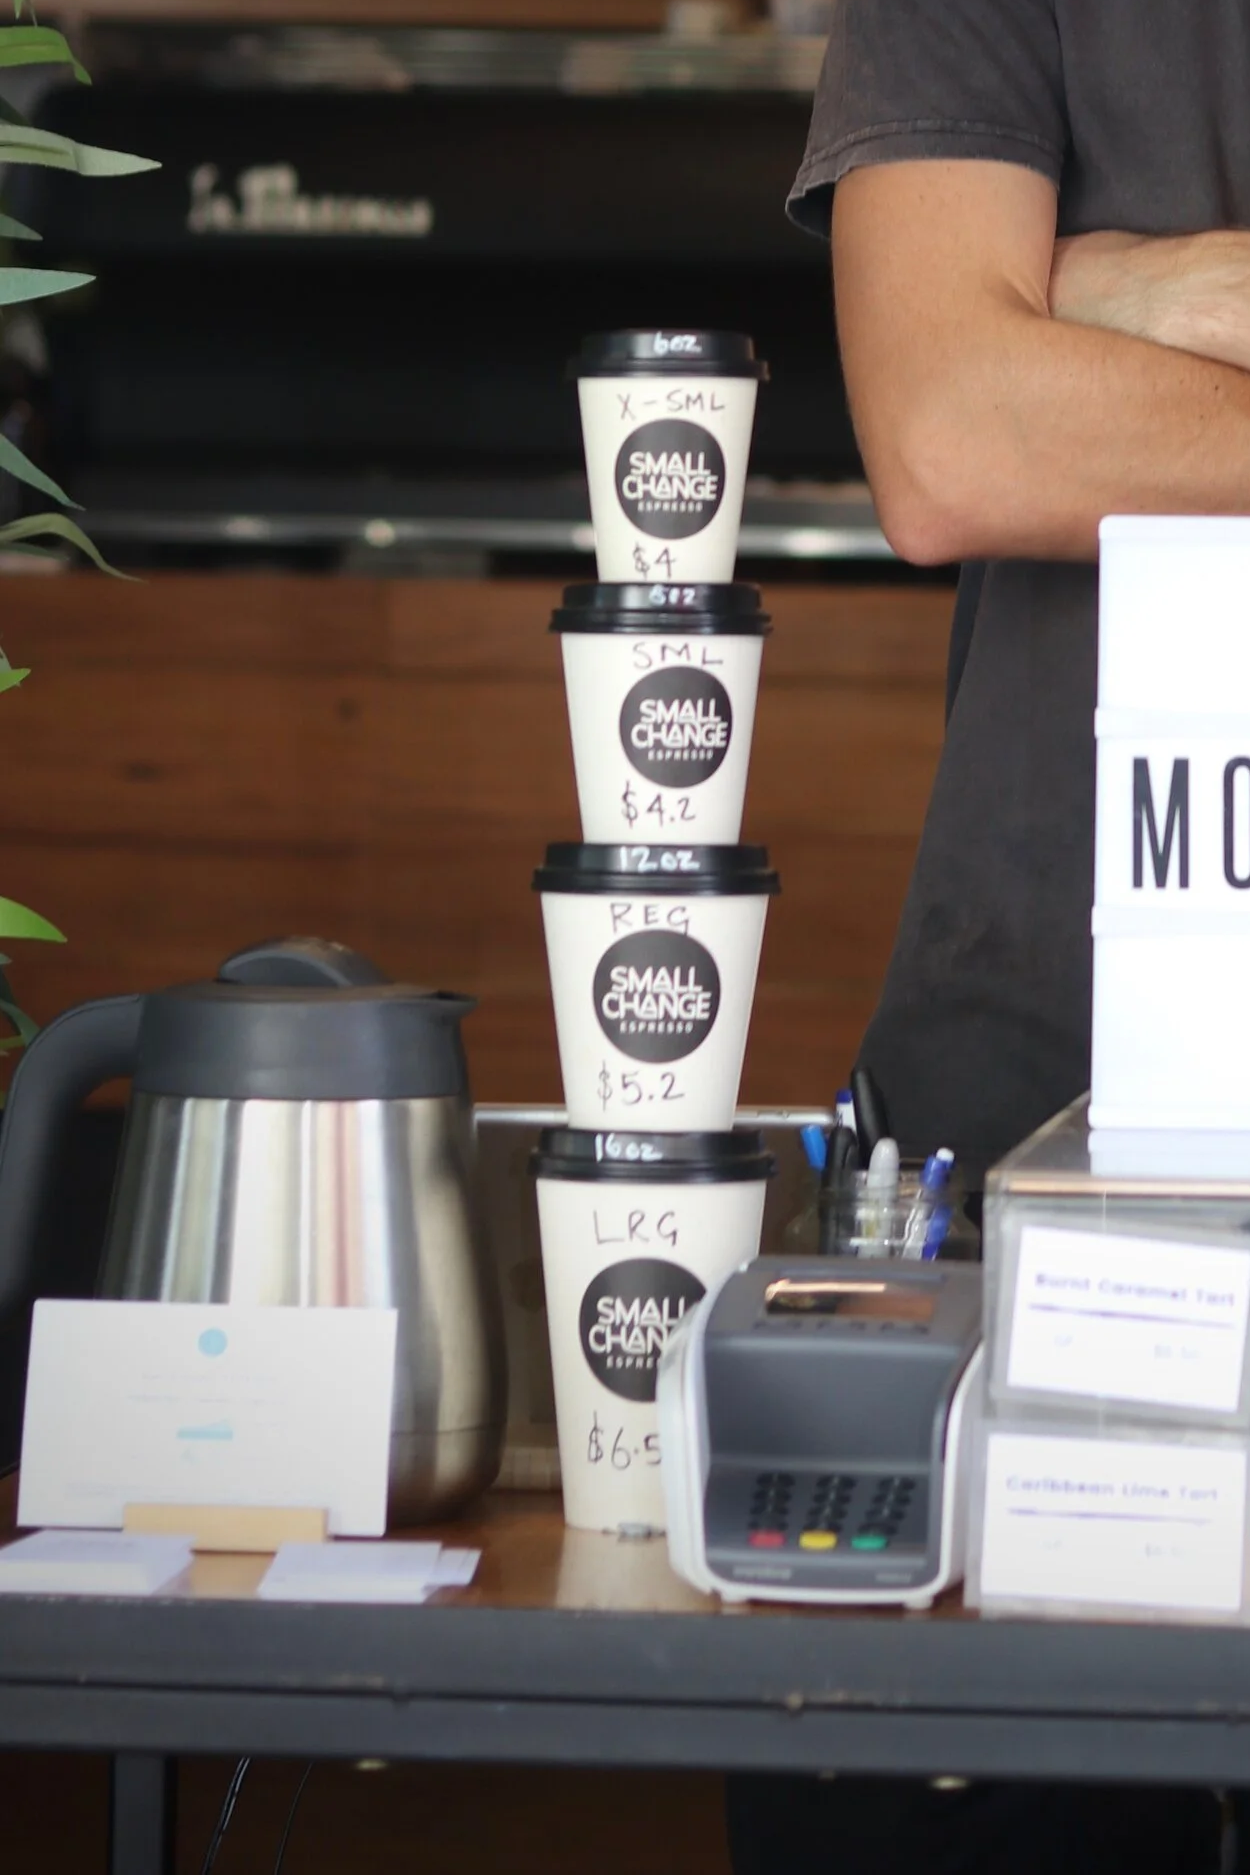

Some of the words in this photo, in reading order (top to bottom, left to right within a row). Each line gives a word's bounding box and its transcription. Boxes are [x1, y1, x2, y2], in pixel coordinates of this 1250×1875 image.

[629, 451, 711, 476] SMALL
[622, 475, 719, 501] CHANGE
[637, 501, 703, 513] ESPRESSO
[632, 541, 676, 580] $4
[633, 641, 723, 670] SML
[639, 698, 721, 724] SMALL
[631, 722, 729, 749] CHANGE
[647, 750, 714, 761] ESPRESSO
[621, 780, 697, 830] $4.2
[609, 902, 690, 936] REG
[610, 966, 703, 994] SMALL
[602, 992, 712, 1020] CHANGE
[619, 1021, 693, 1034] ESPRESSO
[597, 1060, 685, 1111] $5.2
[593, 1209, 680, 1247] LRG
[588, 1323, 668, 1355] CHAN
[606, 1356, 660, 1370] ESPRE
